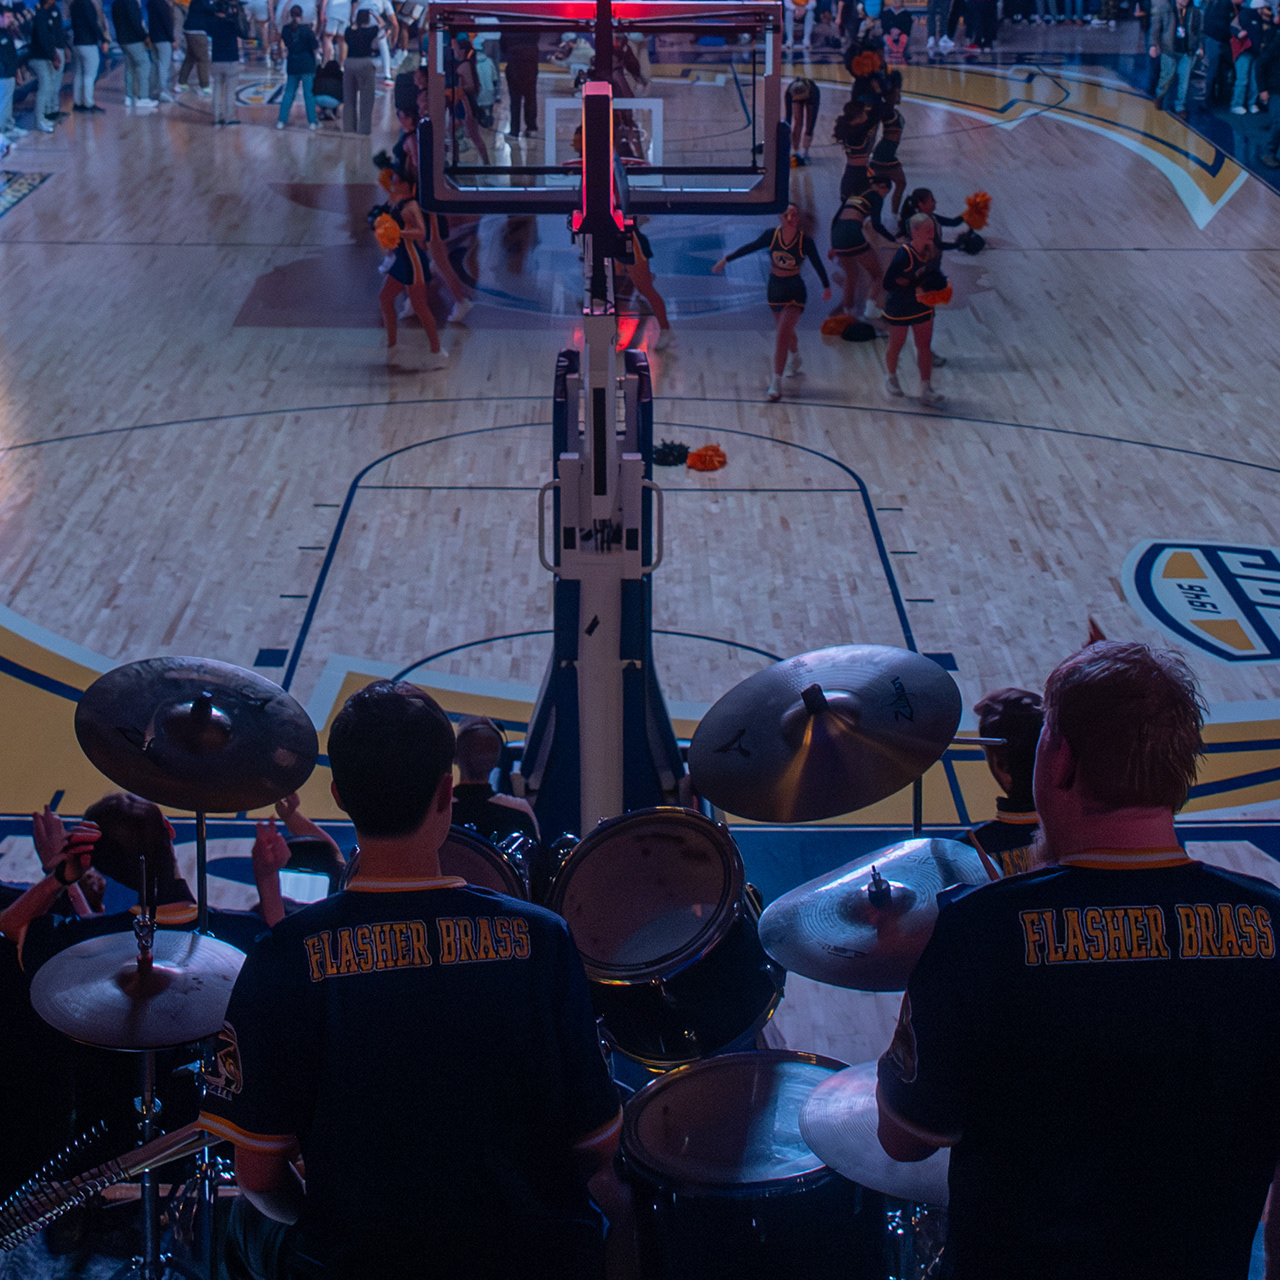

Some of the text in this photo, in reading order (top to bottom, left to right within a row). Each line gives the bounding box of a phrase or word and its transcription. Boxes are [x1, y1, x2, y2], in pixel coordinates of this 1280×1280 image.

[1175, 582, 1223, 616] 1946
[302, 916, 532, 983] FLASHER BRASS
[1019, 902, 1276, 968] FLASHER BRASS
